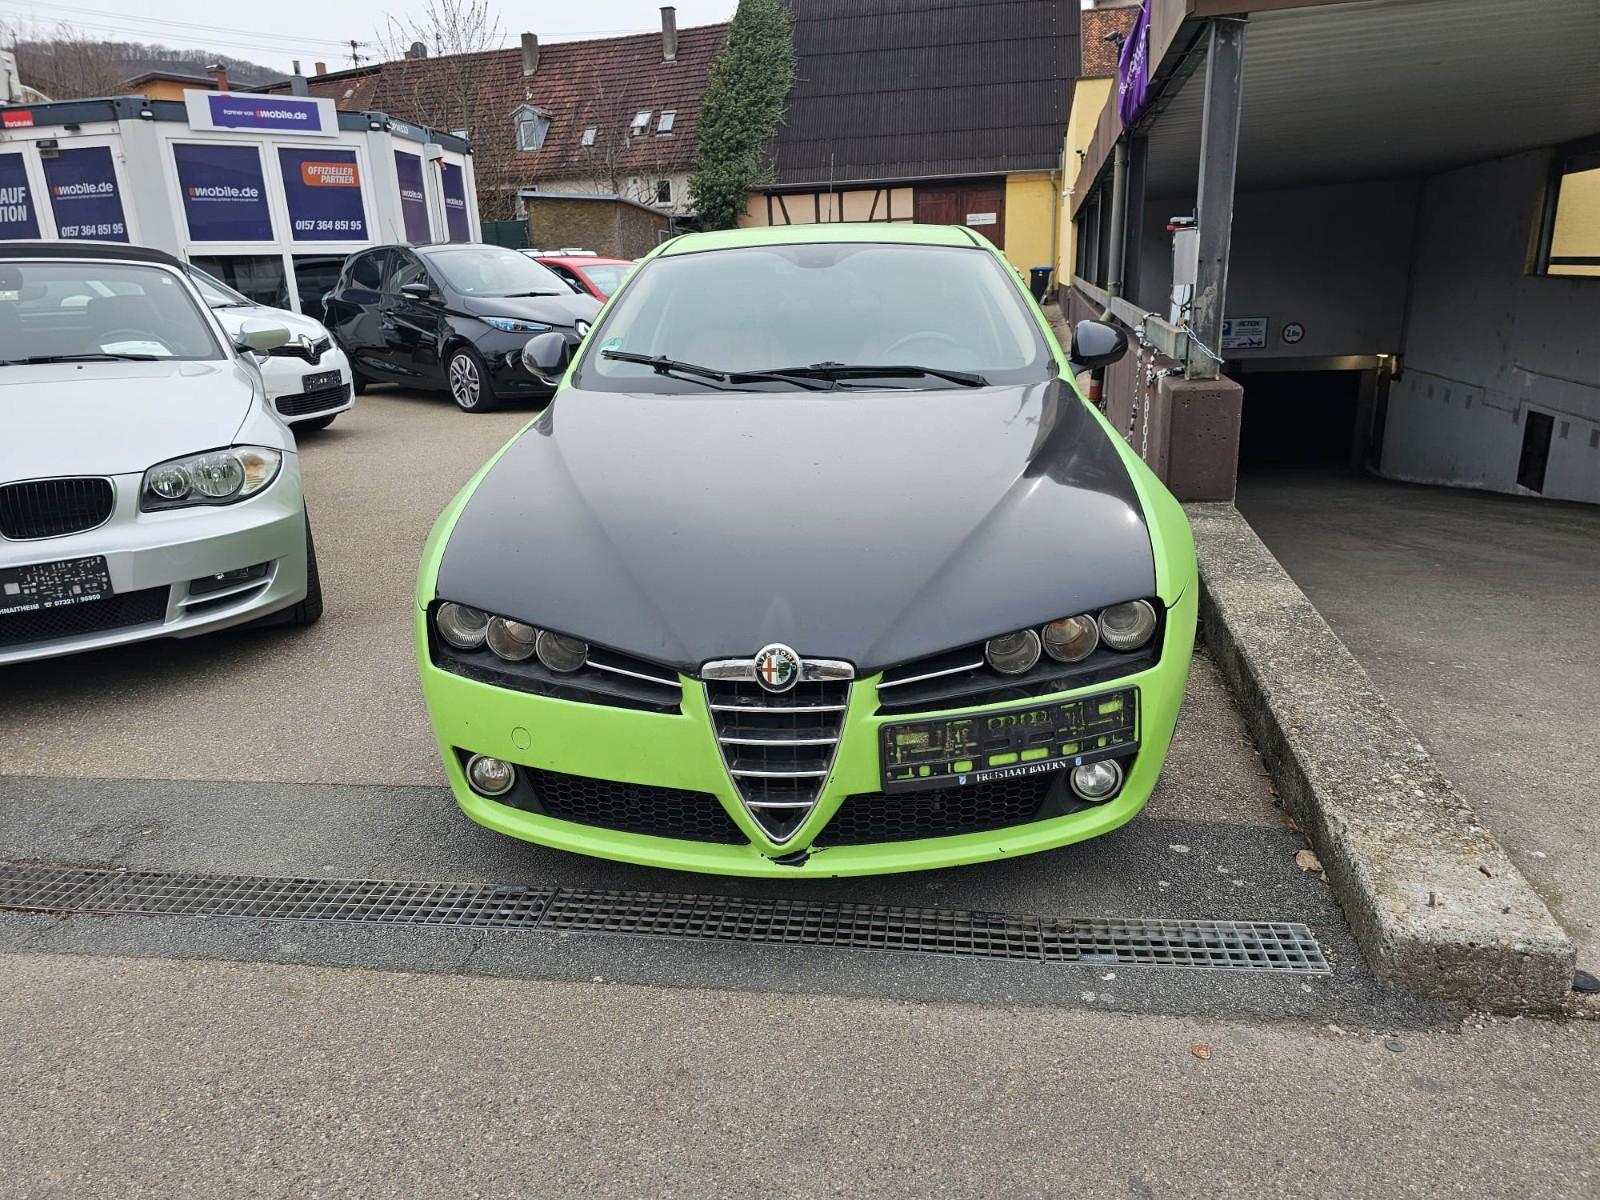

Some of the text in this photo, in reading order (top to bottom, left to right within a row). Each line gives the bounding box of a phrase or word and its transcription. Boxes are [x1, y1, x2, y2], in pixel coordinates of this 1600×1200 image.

[307, 166, 353, 176] OFFIZIELLER
[321, 175, 354, 185] PARTNER
[58, 182, 114, 196] mobile.de
[194, 186, 259, 198] mobile.de
[61, 223, 124, 237] 0157 364 851 95
[295, 220, 362, 231] 0157 364 851 95
